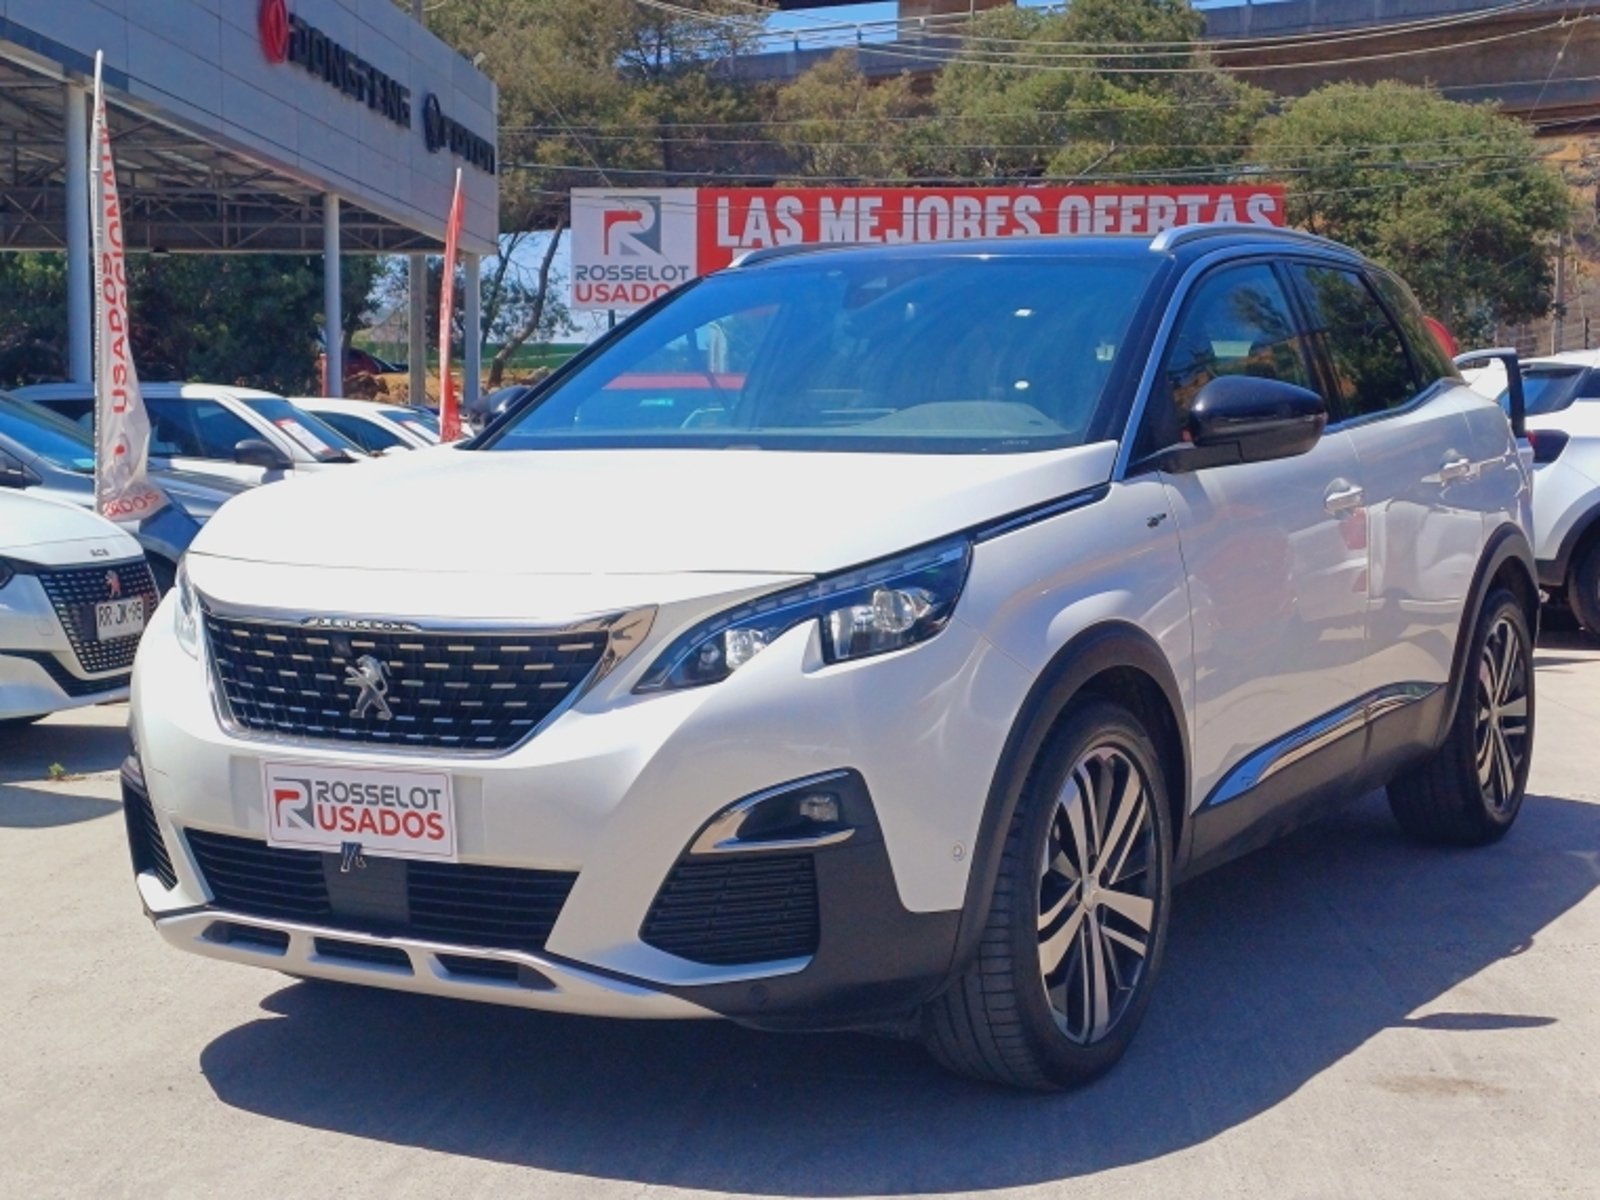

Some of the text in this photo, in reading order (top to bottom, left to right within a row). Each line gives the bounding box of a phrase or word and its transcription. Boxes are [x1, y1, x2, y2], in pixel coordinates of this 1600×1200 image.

[717, 193, 1277, 248] LAS MEJORES OFERTAS
[575, 264, 690, 282] ROSSELOT
[575, 283, 672, 304] USADO
[106, 252, 128, 414] USADOS
[315, 780, 441, 811] ROSSELOT
[317, 804, 445, 841] USADOS
